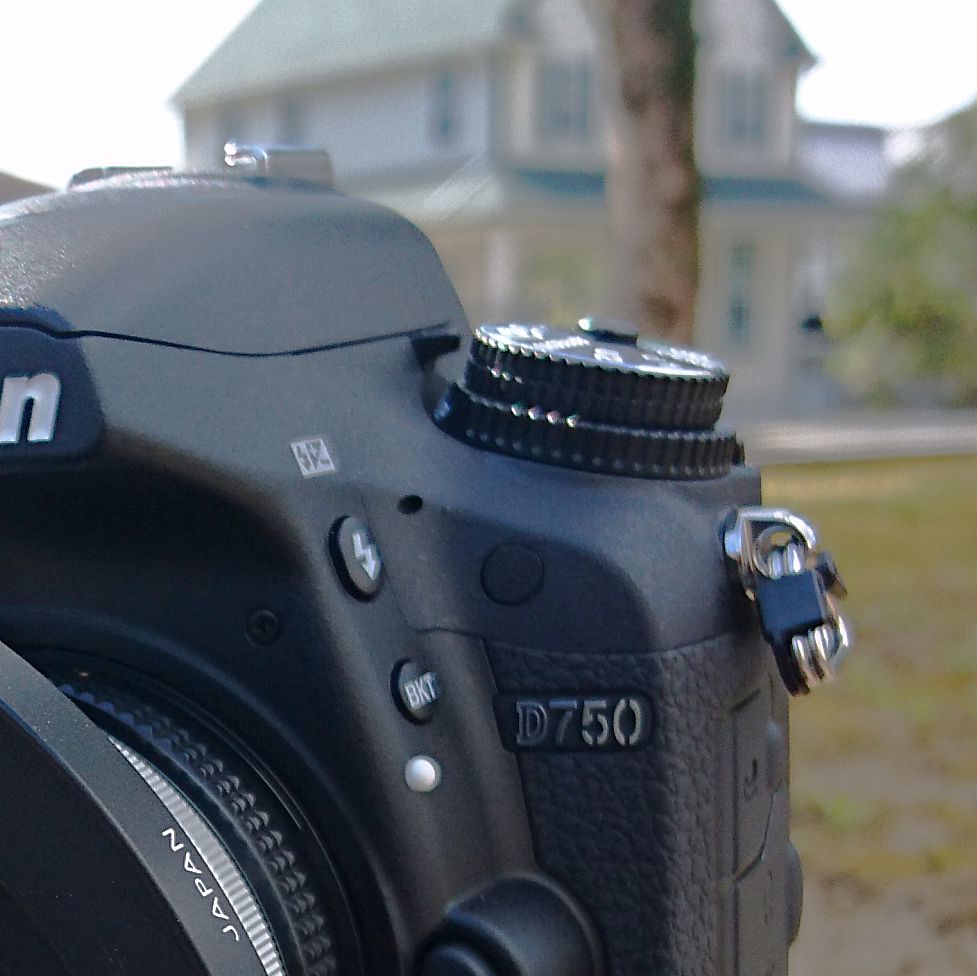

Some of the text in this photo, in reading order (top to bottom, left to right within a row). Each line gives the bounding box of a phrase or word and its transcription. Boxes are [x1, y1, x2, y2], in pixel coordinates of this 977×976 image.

[405, 672, 435, 709] BKT
[516, 699, 642, 746] D750
[162, 828, 240, 941] JAPAN
